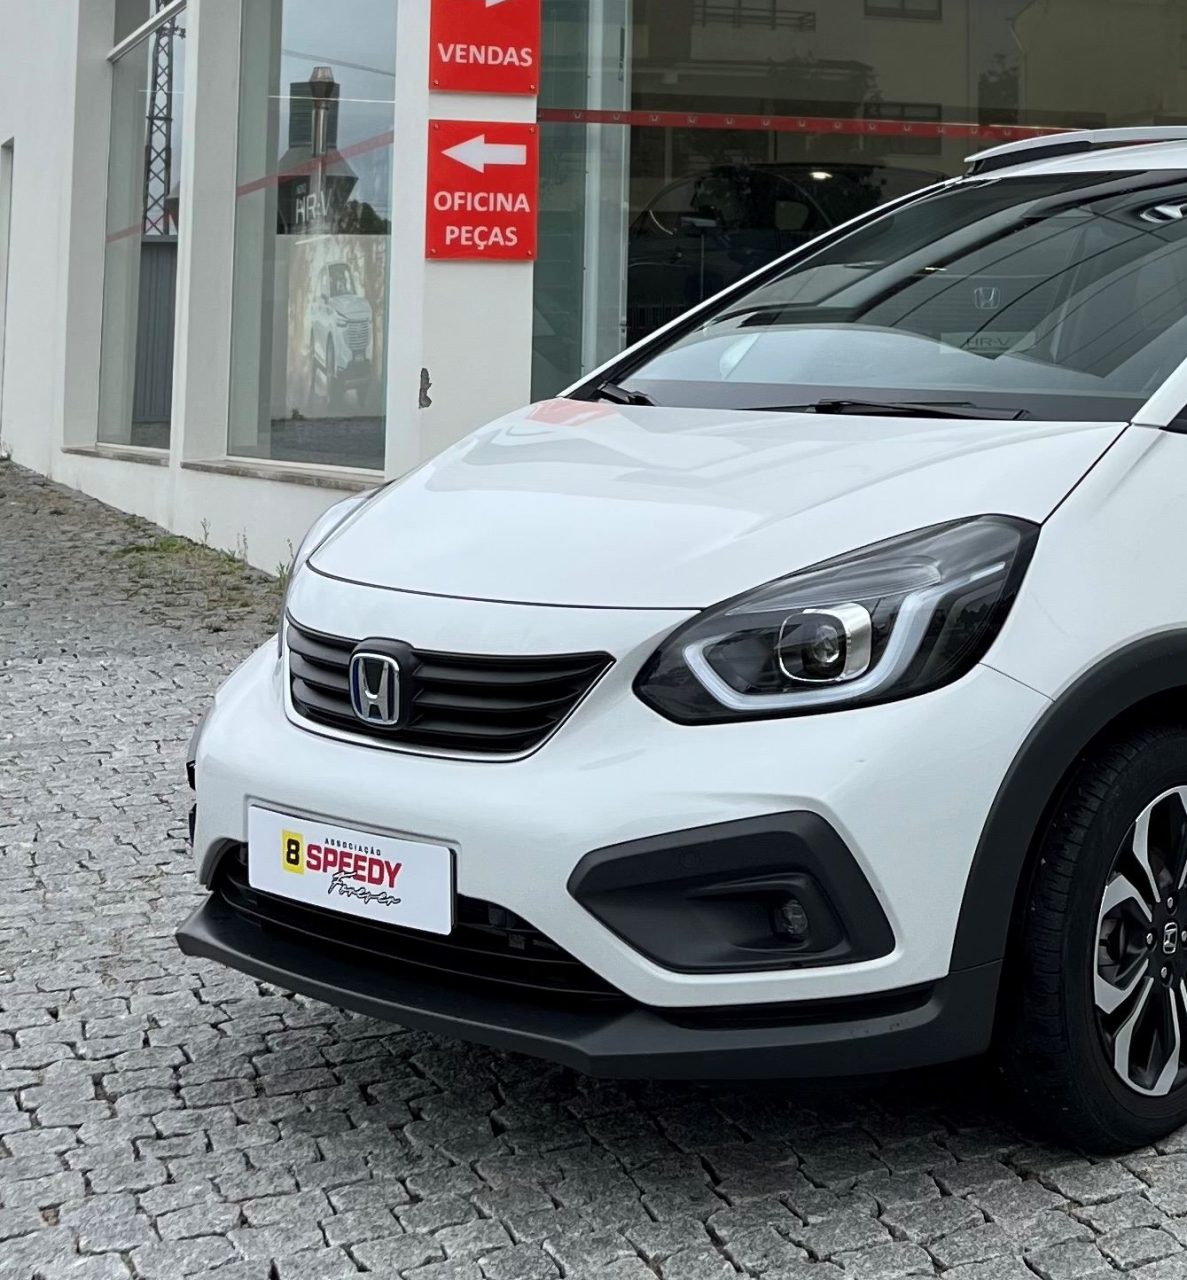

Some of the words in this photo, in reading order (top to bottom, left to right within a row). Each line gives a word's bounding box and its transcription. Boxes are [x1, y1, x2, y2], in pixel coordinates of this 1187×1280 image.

[438, 43, 533, 66] VENDAS
[433, 191, 530, 212] OFICINA
[445, 226, 518, 250] PEÇAS
[324, 838, 382, 856] ASSOCIAÇÃO
[286, 838, 300, 865] 8
[306, 843, 402, 888] SPEEDY
